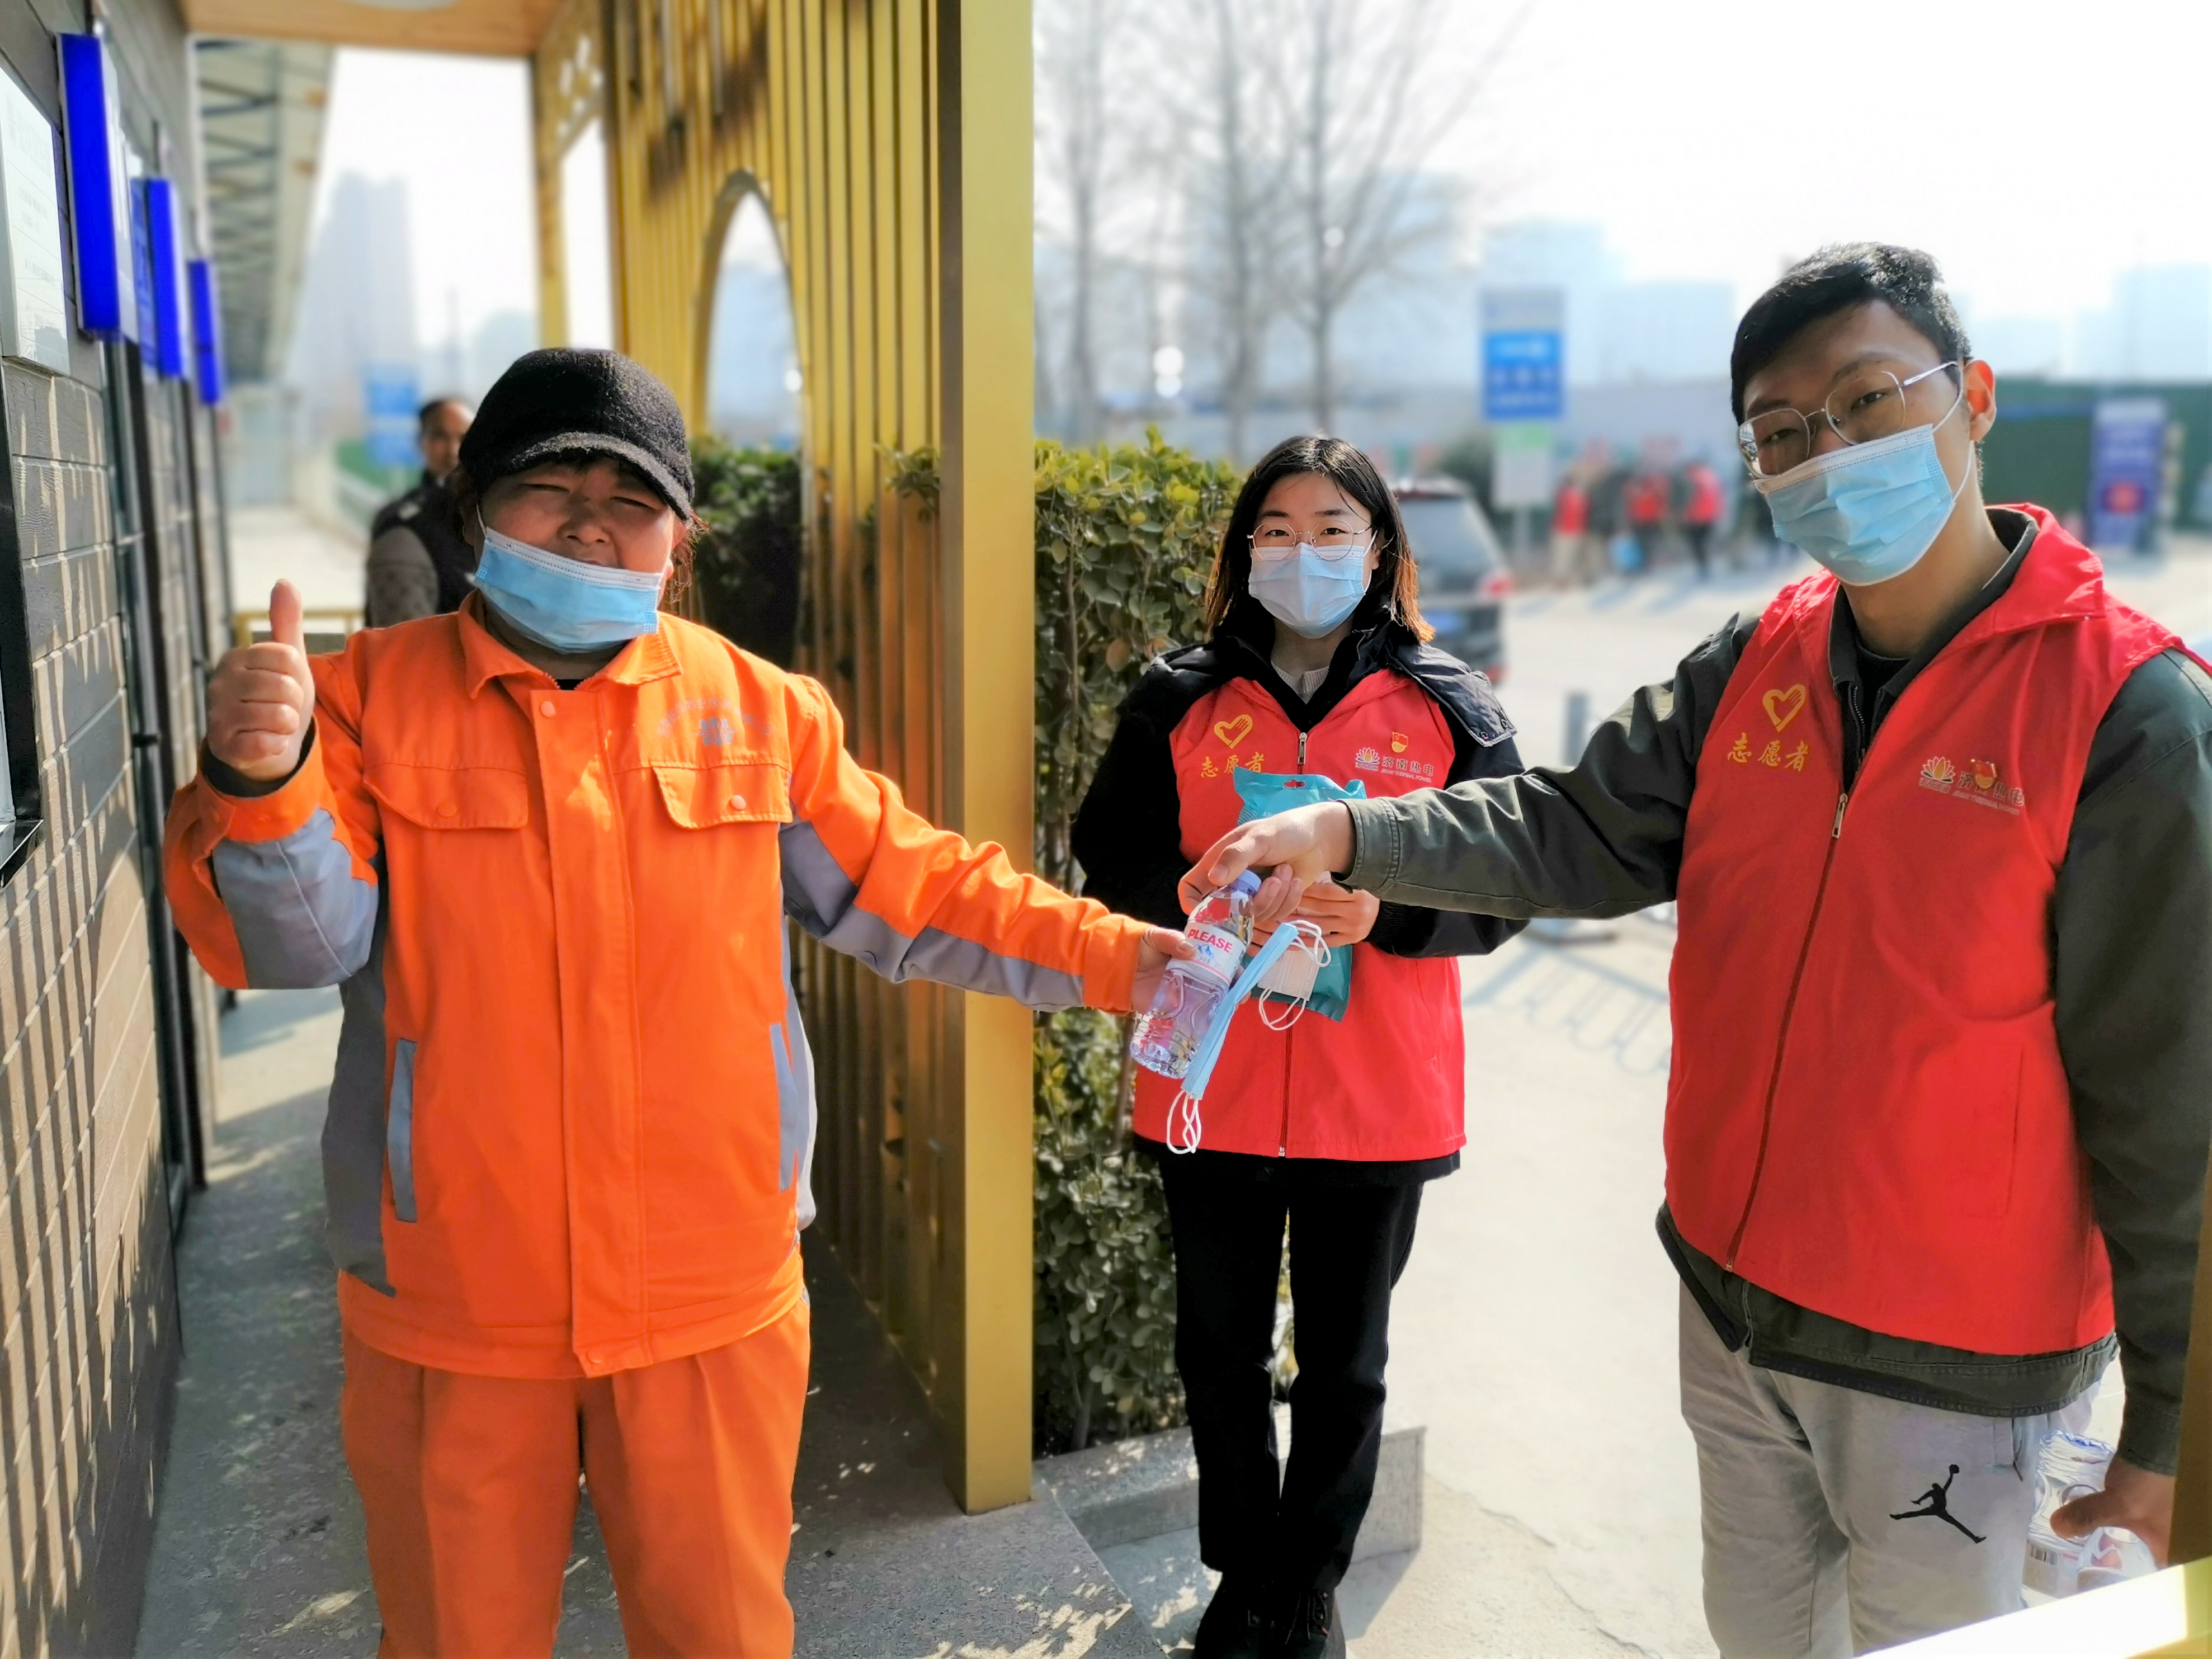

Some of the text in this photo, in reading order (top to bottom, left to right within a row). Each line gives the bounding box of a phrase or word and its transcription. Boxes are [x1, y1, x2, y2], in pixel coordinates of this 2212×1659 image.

[1728, 732, 1808, 772] 志愿者
[1200, 752, 1265, 778] 志愿者
[1382, 756, 1434, 776] 济南热电
[1187, 929, 1233, 954] PLEASE
